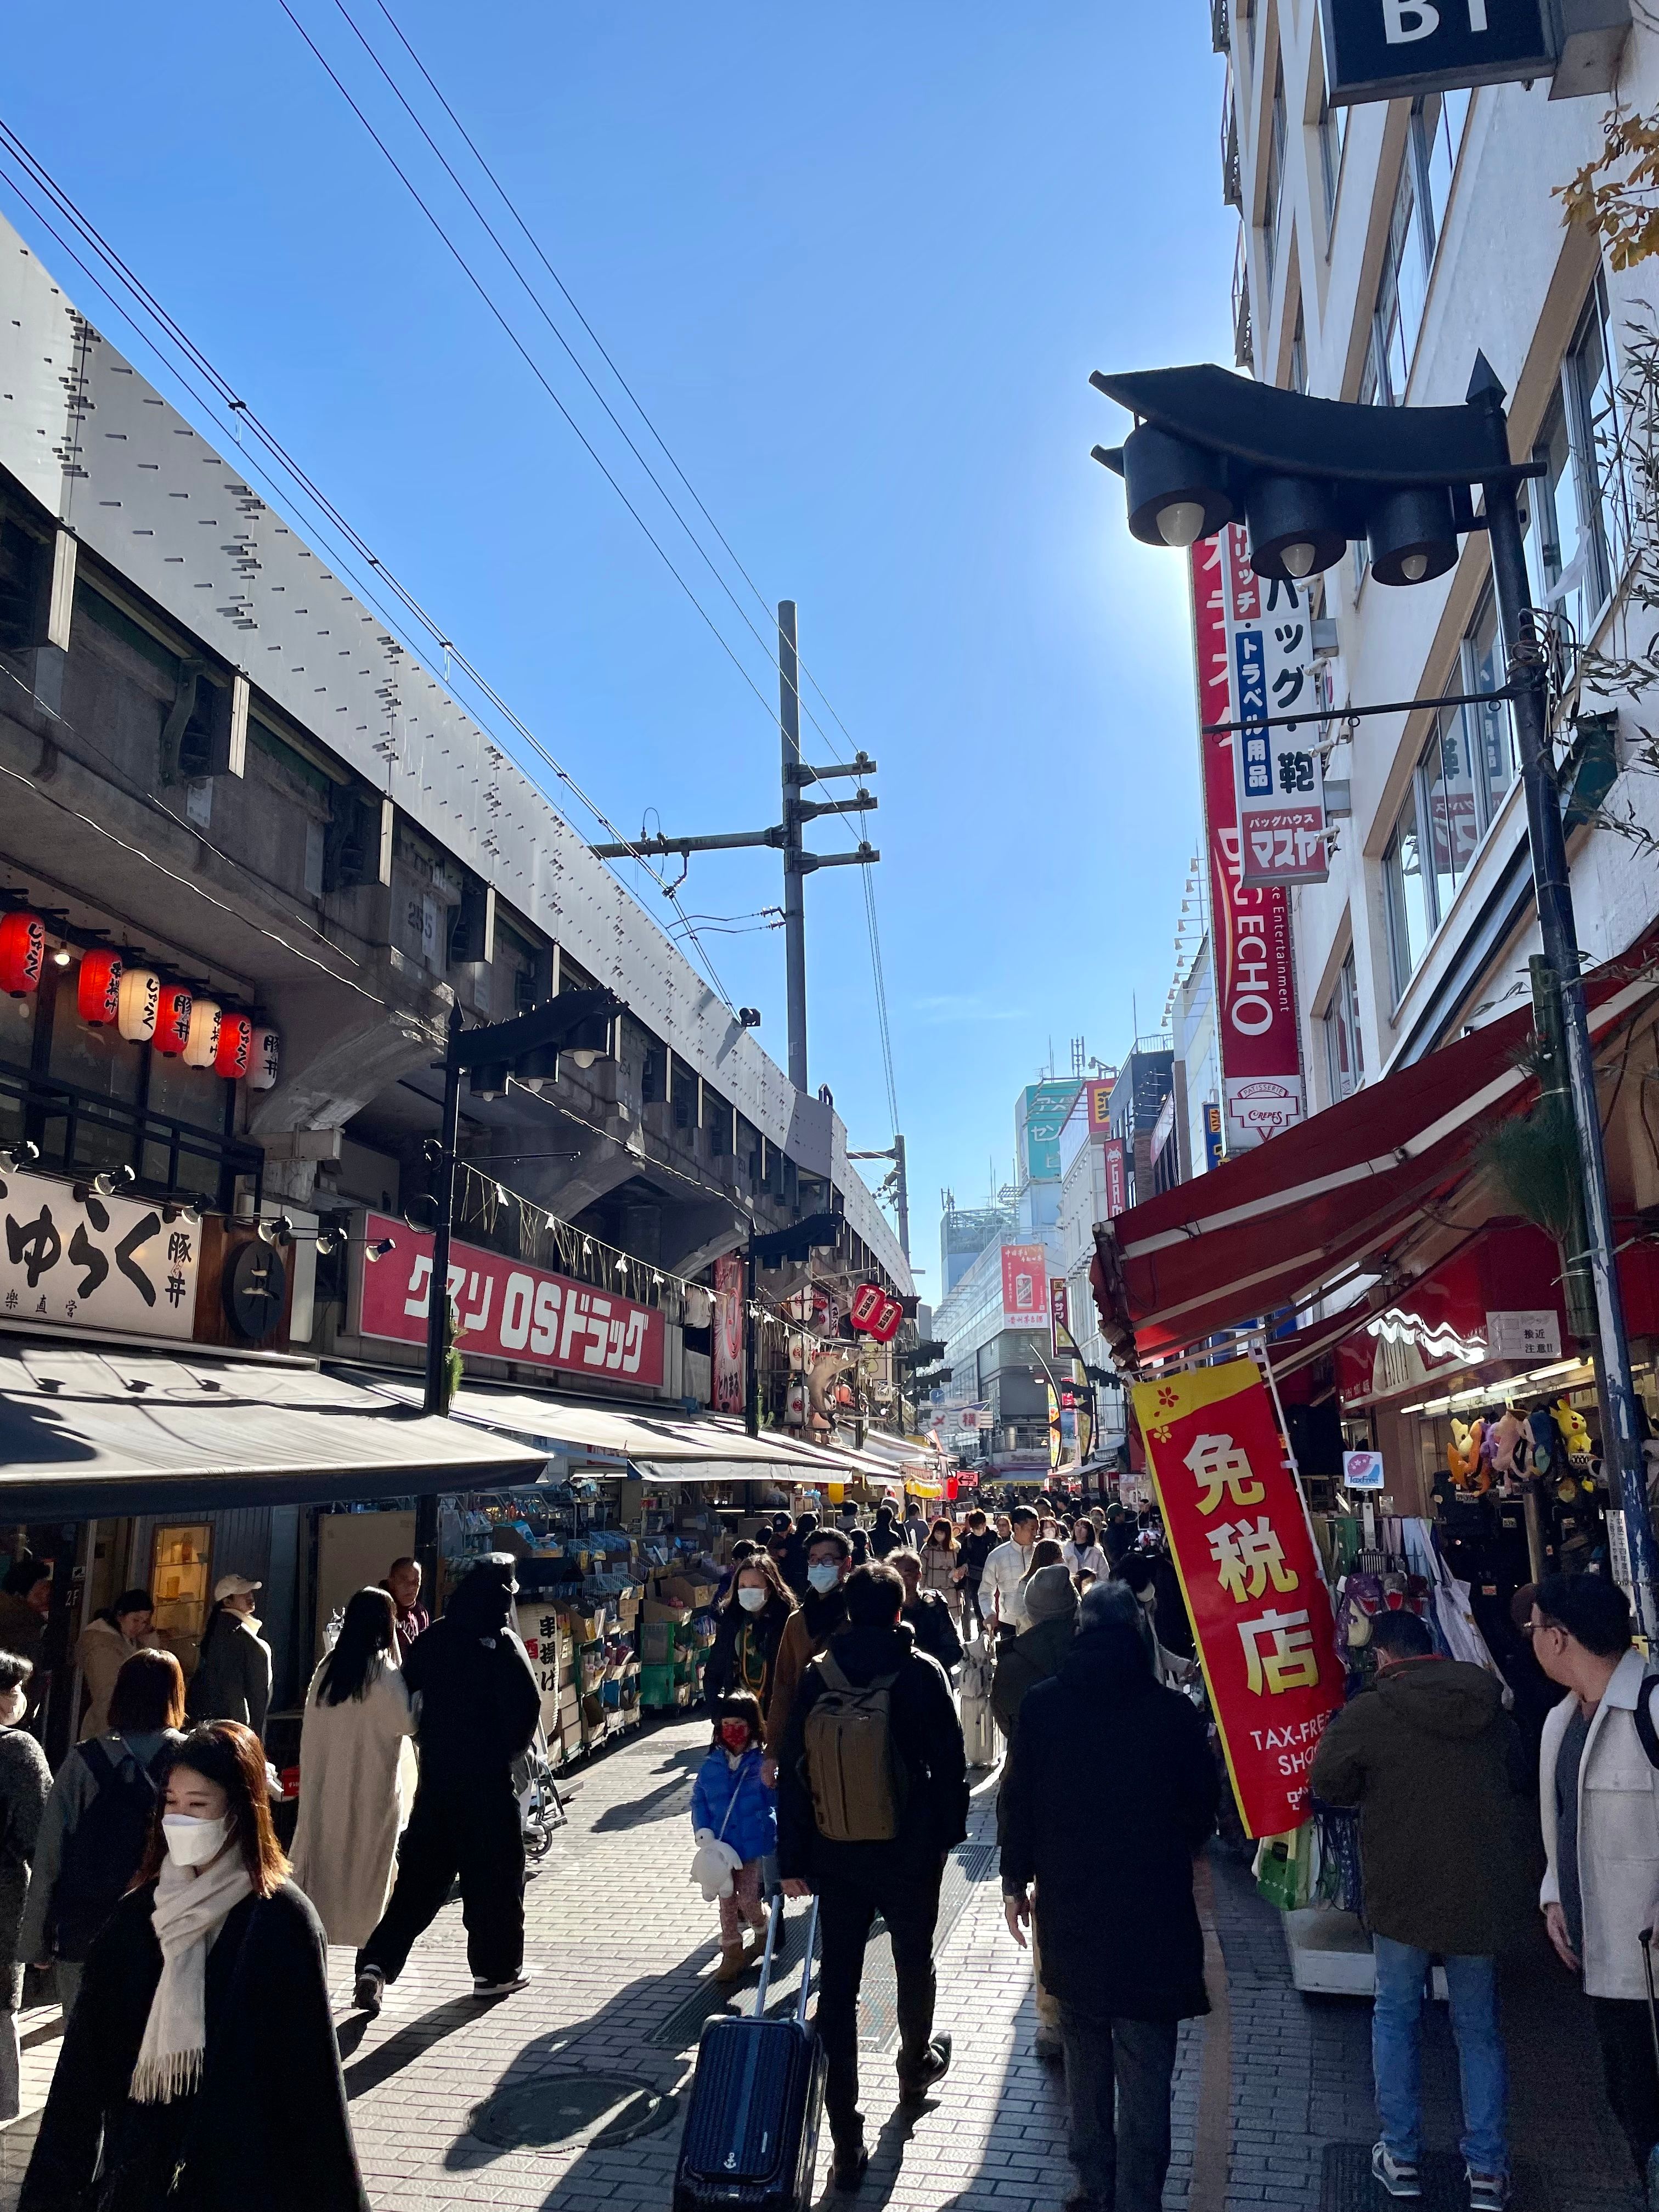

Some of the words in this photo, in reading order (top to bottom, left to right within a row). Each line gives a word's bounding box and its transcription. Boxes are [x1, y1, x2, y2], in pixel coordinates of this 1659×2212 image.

[1249, 814, 1314, 828] バッグハウス
[1251, 827, 1321, 868] マスヤ
[1231, 915, 1273, 1036] ECHO
[1273, 906, 1290, 1012] Entertainment
[1243, 1084, 1284, 1096] PATISSERIE
[1248, 1109, 1282, 1125] CREPES
[165, 1232, 192, 1308] 豚丼
[500, 1271, 649, 1374] OSドラッグ
[1523, 1328, 1545, 1339] 接近
[1182, 1433, 1319, 1696] 免税店
[1278, 1738, 1320, 1776] SHO
